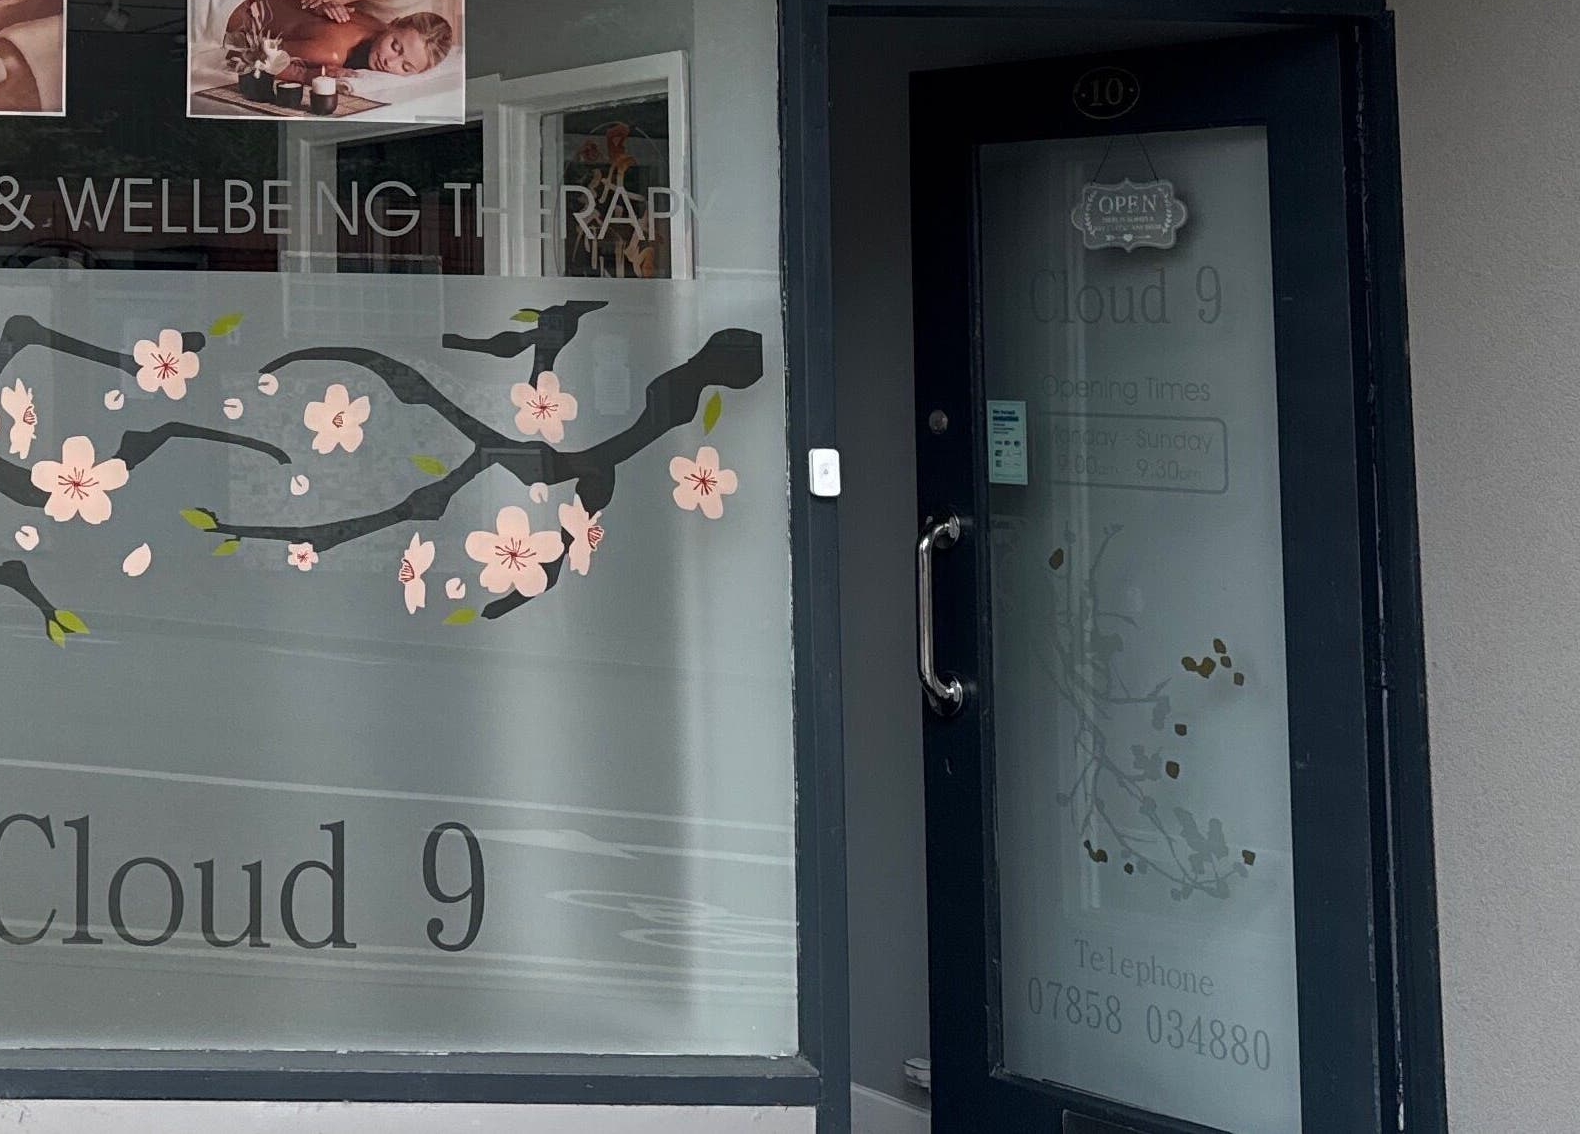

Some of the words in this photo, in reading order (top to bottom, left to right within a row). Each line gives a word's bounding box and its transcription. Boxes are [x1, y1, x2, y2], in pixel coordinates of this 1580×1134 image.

[1090, 72, 1123, 106] 10
[57, 176, 421, 237] WELLBENG
[1099, 194, 1157, 215] OPEN
[1029, 266, 1171, 324] Cloud
[1195, 265, 1221, 324] 9
[1042, 374, 1138, 406] Opening
[1145, 376, 1211, 402] Times
[1136, 426, 1213, 455] Sunday
[421, 821, 485, 953] 9
[1074, 938, 1214, 996] Telephone
[1028, 977, 1122, 1035] 07858
[1146, 1004, 1271, 1072] 034880
